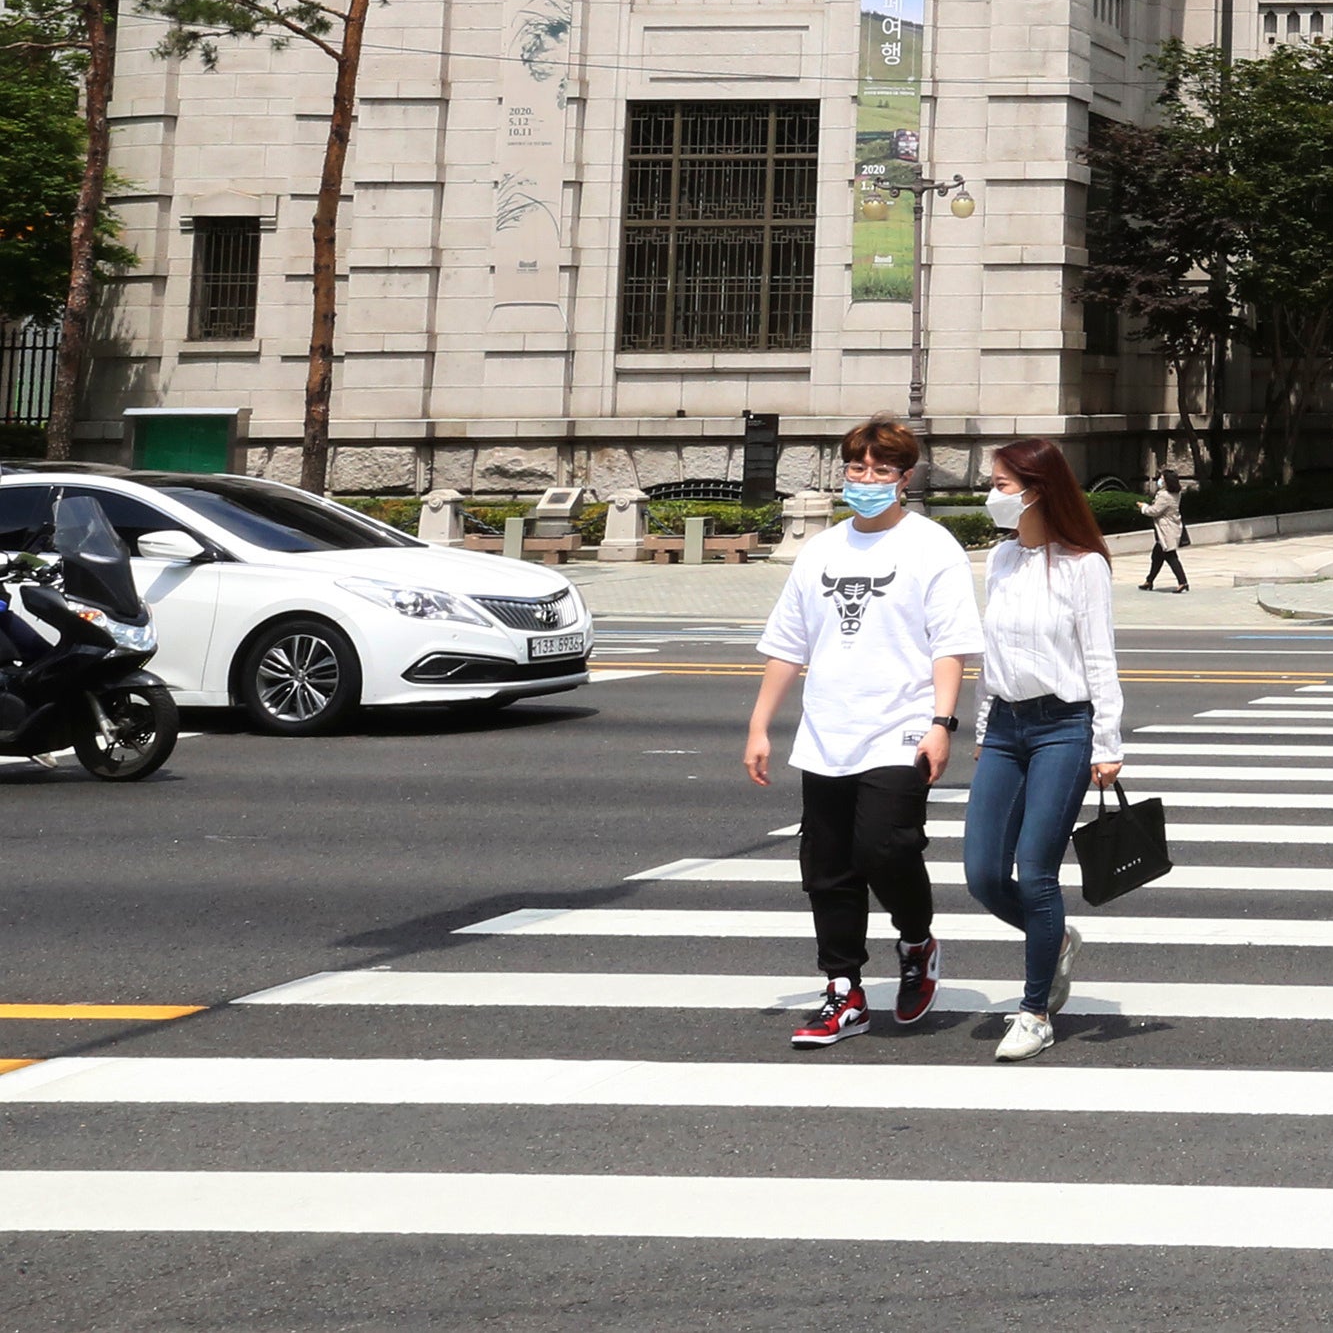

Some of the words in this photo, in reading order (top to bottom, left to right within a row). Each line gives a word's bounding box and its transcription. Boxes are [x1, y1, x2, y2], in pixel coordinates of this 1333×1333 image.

[508, 107, 534, 116] 2020.
[508, 118, 529, 126] 5.12
[508, 128, 532, 136] 10.11
[862, 165, 885, 174] 2020
